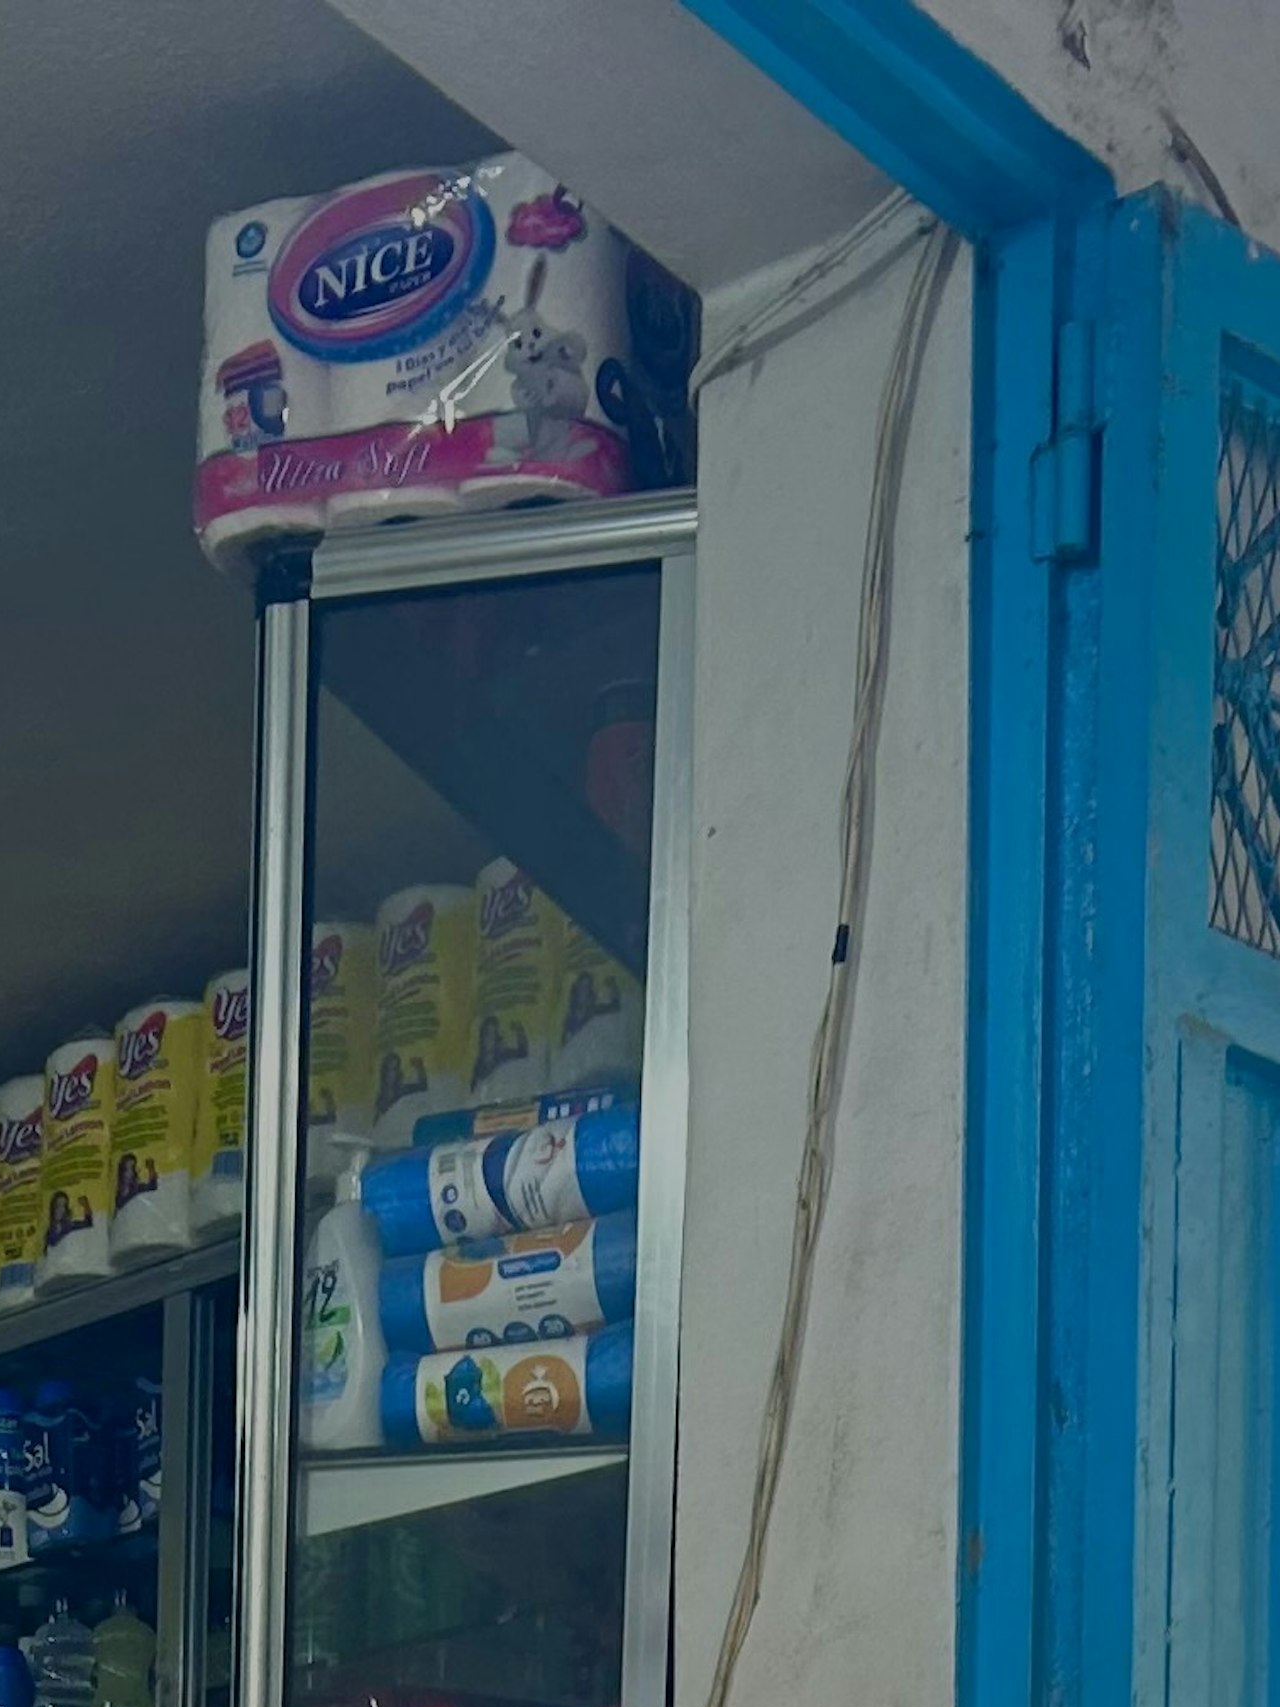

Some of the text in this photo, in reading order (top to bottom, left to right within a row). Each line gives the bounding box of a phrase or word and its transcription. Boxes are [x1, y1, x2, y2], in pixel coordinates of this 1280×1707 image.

[313, 231, 434, 308] NICE
[122, 1029, 160, 1077] yes
[51, 1070, 93, 1119] yes
